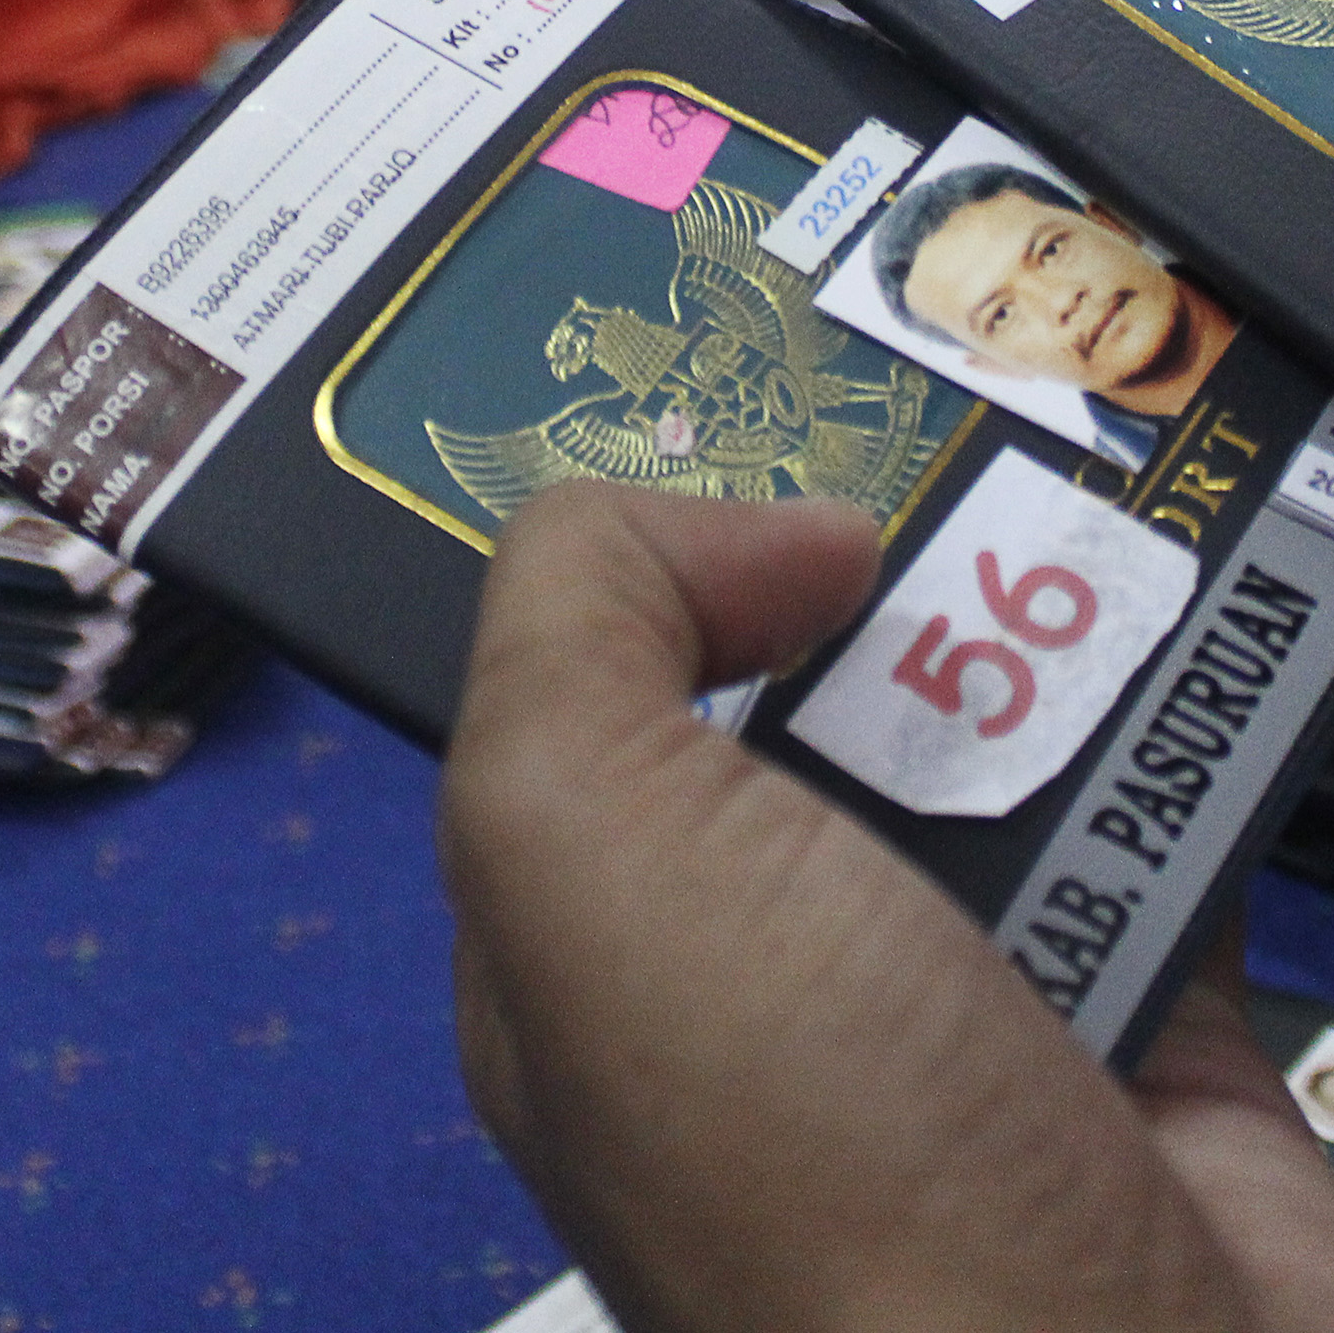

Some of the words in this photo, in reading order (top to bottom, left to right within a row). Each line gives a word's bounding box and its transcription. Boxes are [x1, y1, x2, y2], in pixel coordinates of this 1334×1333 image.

[482, 44, 520, 74] No
[136, 195, 232, 294] B9226396
[798, 154, 884, 240] 23252
[33, 319, 131, 430] PASPOR
[37, 459, 84, 507] NO.
[72, 369, 150, 456] PORSI
[79, 453, 152, 538] NAMA
[892, 549, 1099, 740] 56
[1090, 563, 1320, 873] PASURUAN
